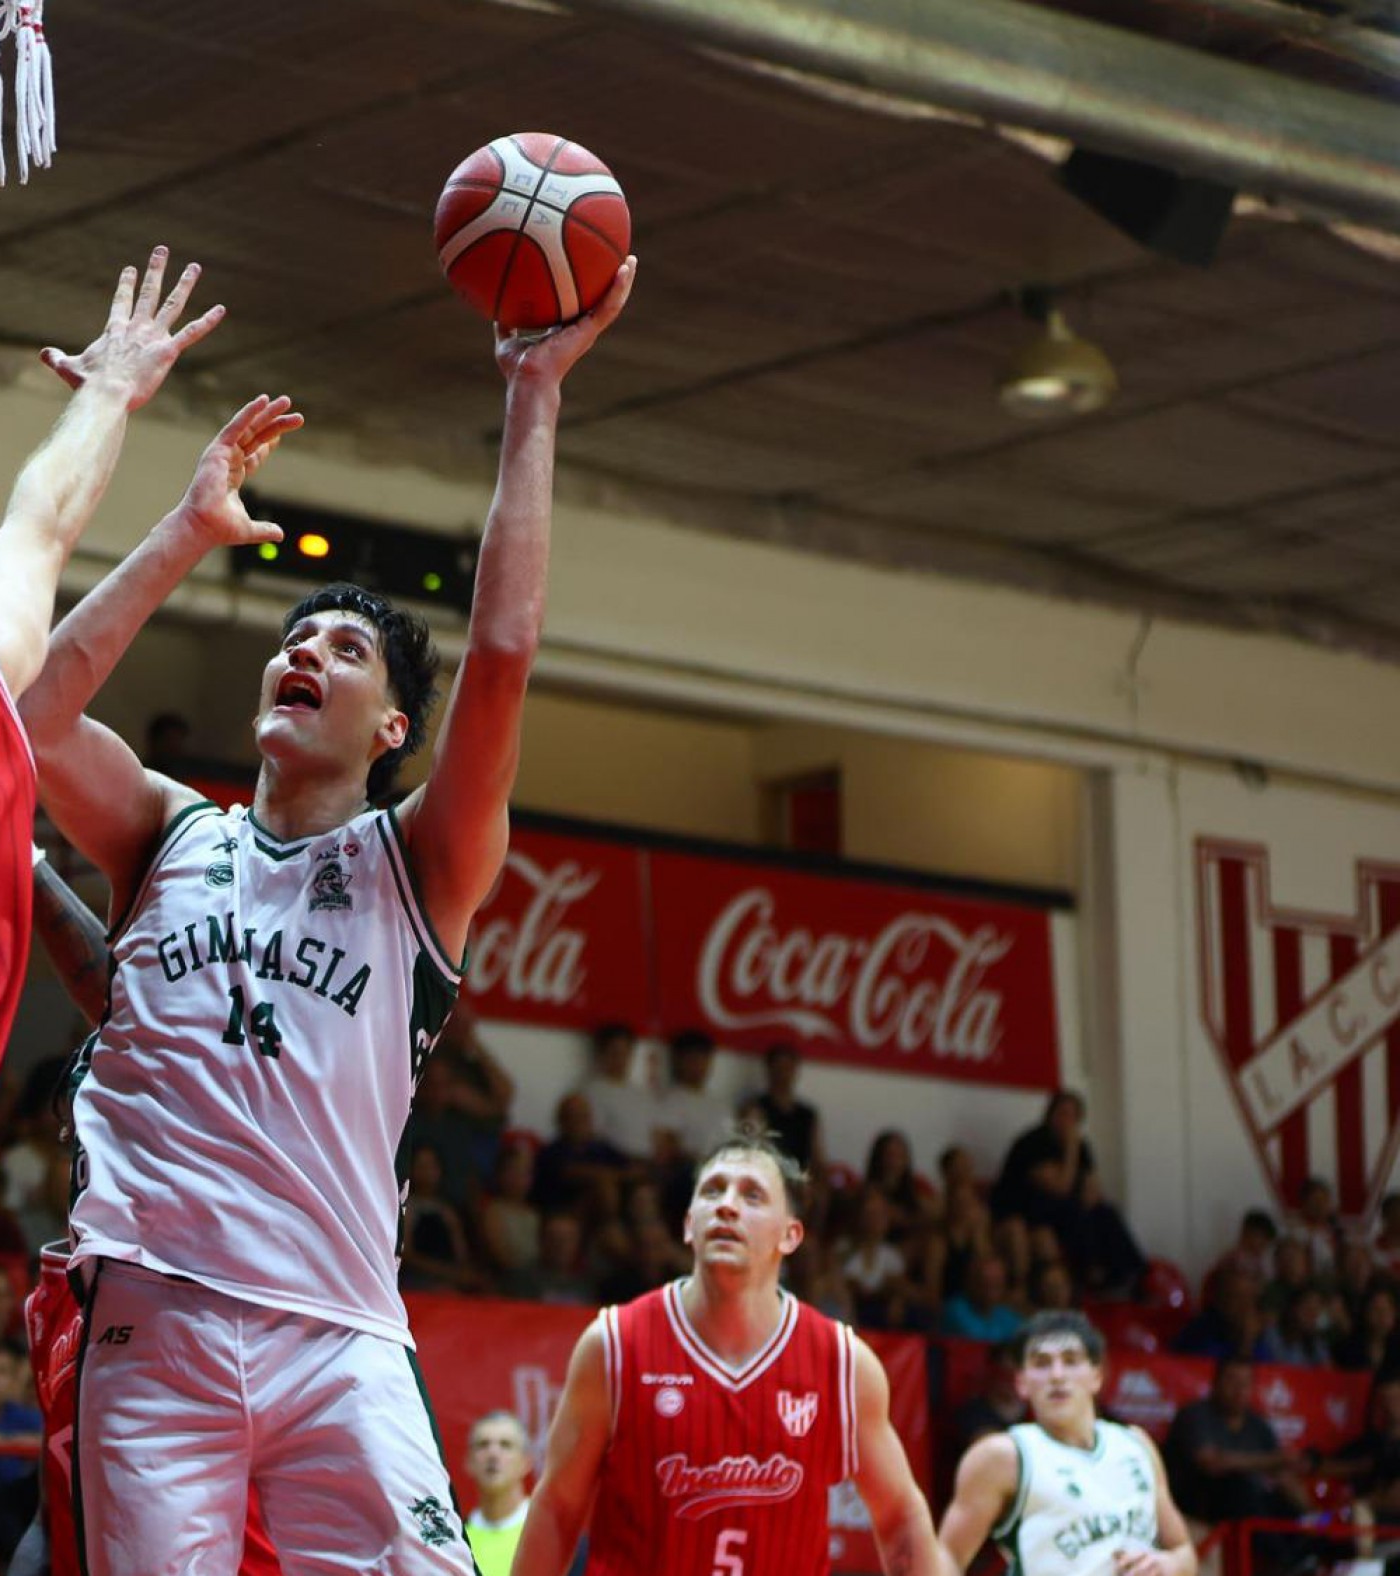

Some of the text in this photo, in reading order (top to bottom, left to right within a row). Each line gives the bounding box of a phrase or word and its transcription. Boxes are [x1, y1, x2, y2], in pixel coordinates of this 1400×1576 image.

[221, 984, 283, 1060] 14
[96, 1325, 135, 1344] AS
[712, 1530, 748, 1576] 5
